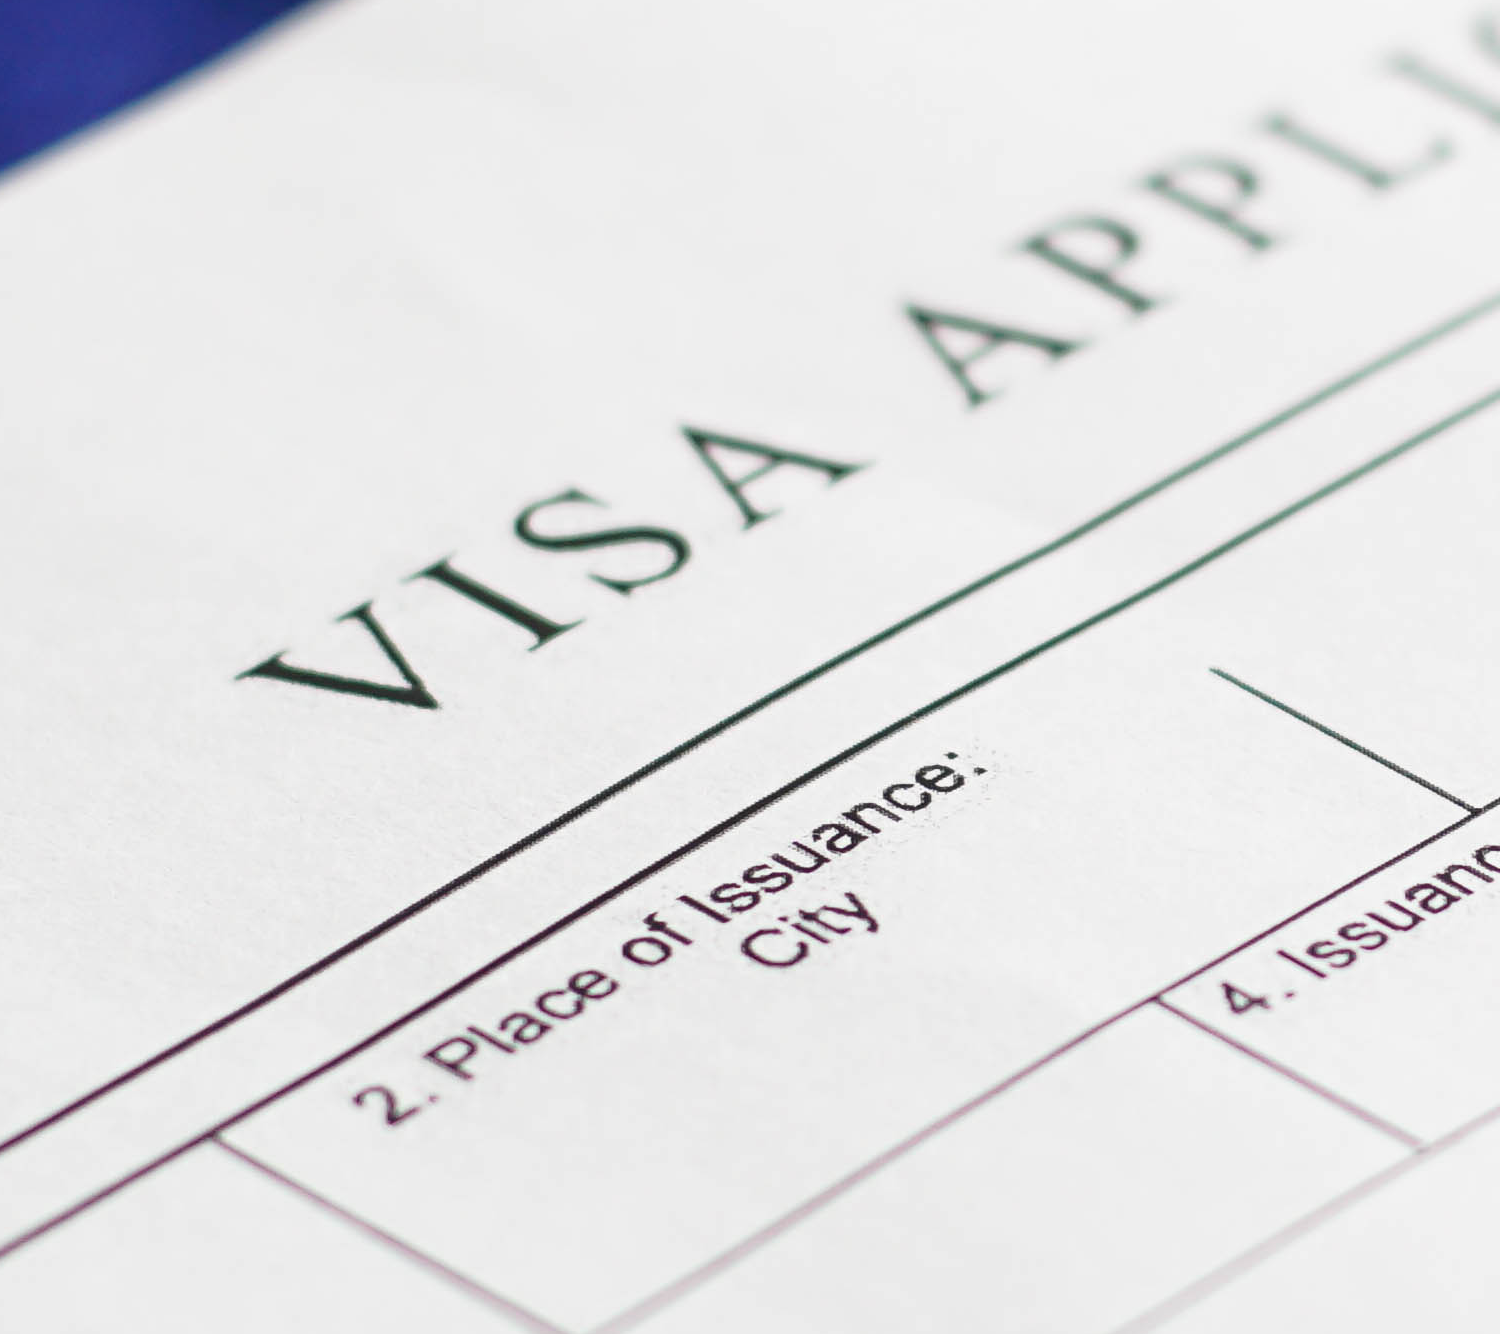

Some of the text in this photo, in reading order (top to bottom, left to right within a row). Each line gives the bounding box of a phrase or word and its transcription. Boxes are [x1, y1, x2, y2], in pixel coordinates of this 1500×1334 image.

[235, 419, 872, 713] VISA
[353, 750, 987, 1127] 2. Place of Issuance:
[740, 889, 880, 970] City
[1220, 977, 1296, 1017] 4.
